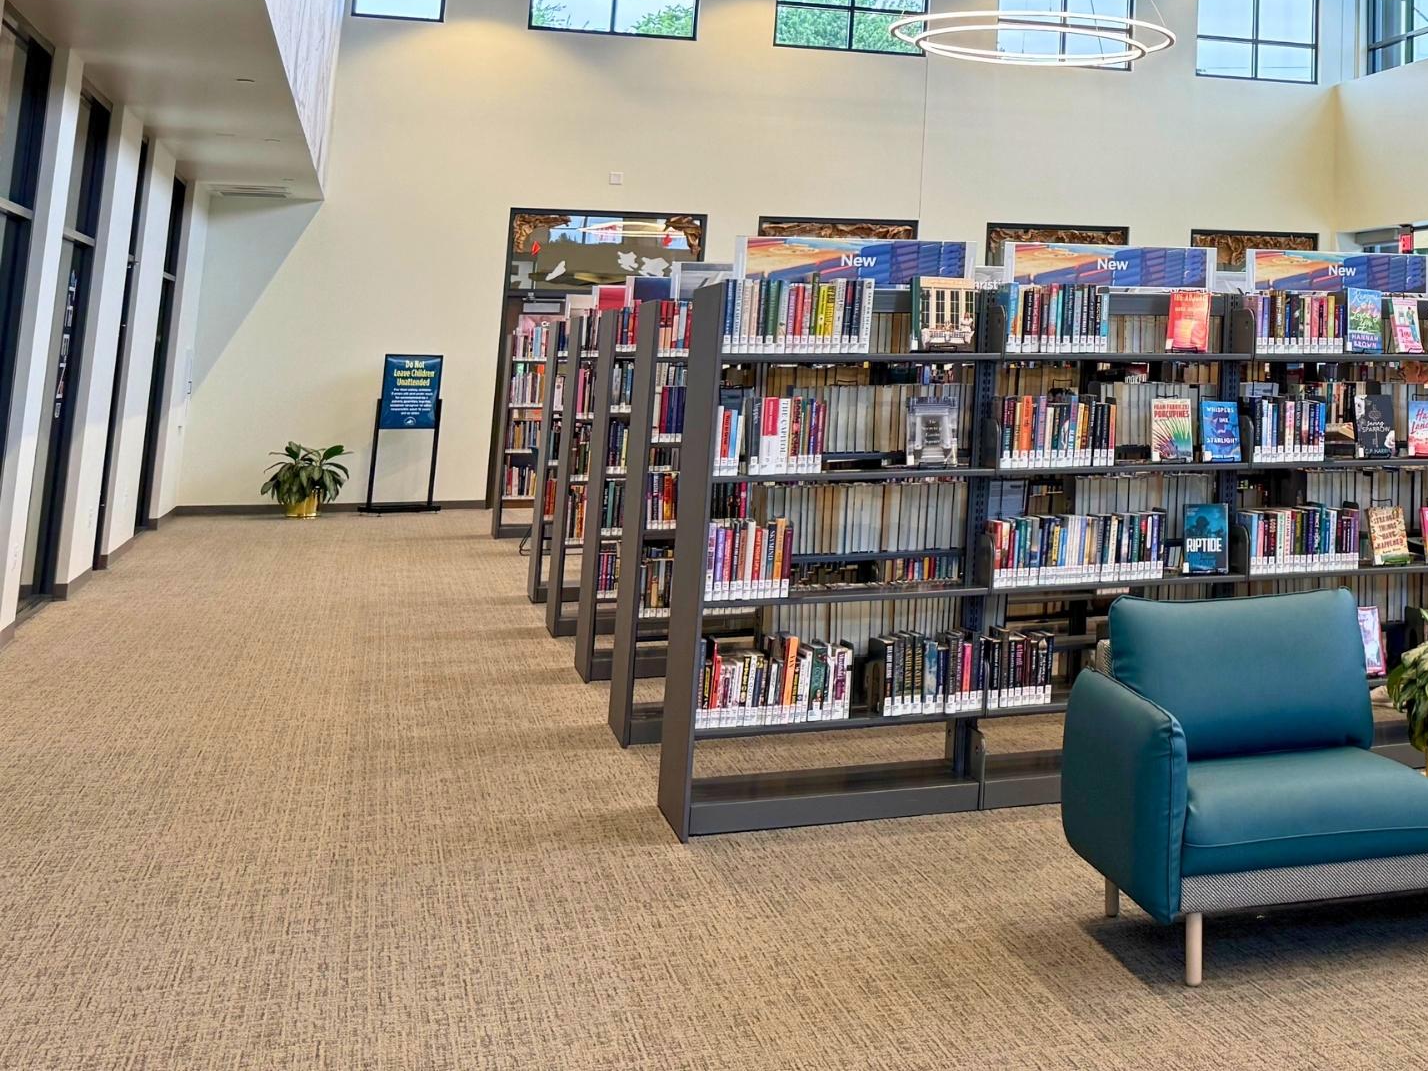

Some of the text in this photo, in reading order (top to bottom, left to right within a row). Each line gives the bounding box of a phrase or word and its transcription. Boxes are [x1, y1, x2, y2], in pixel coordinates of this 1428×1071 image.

[840, 254, 877, 267] New
[1097, 258, 1128, 270] New
[1328, 264, 1356, 276] New
[406, 360, 425, 368] Do Not
[394, 369, 435, 378] Leave Children
[396, 378, 430, 386] Unattended
[1154, 410, 1190, 418] PORCUPINES
[1186, 538, 1222, 552] RIPTIDE
